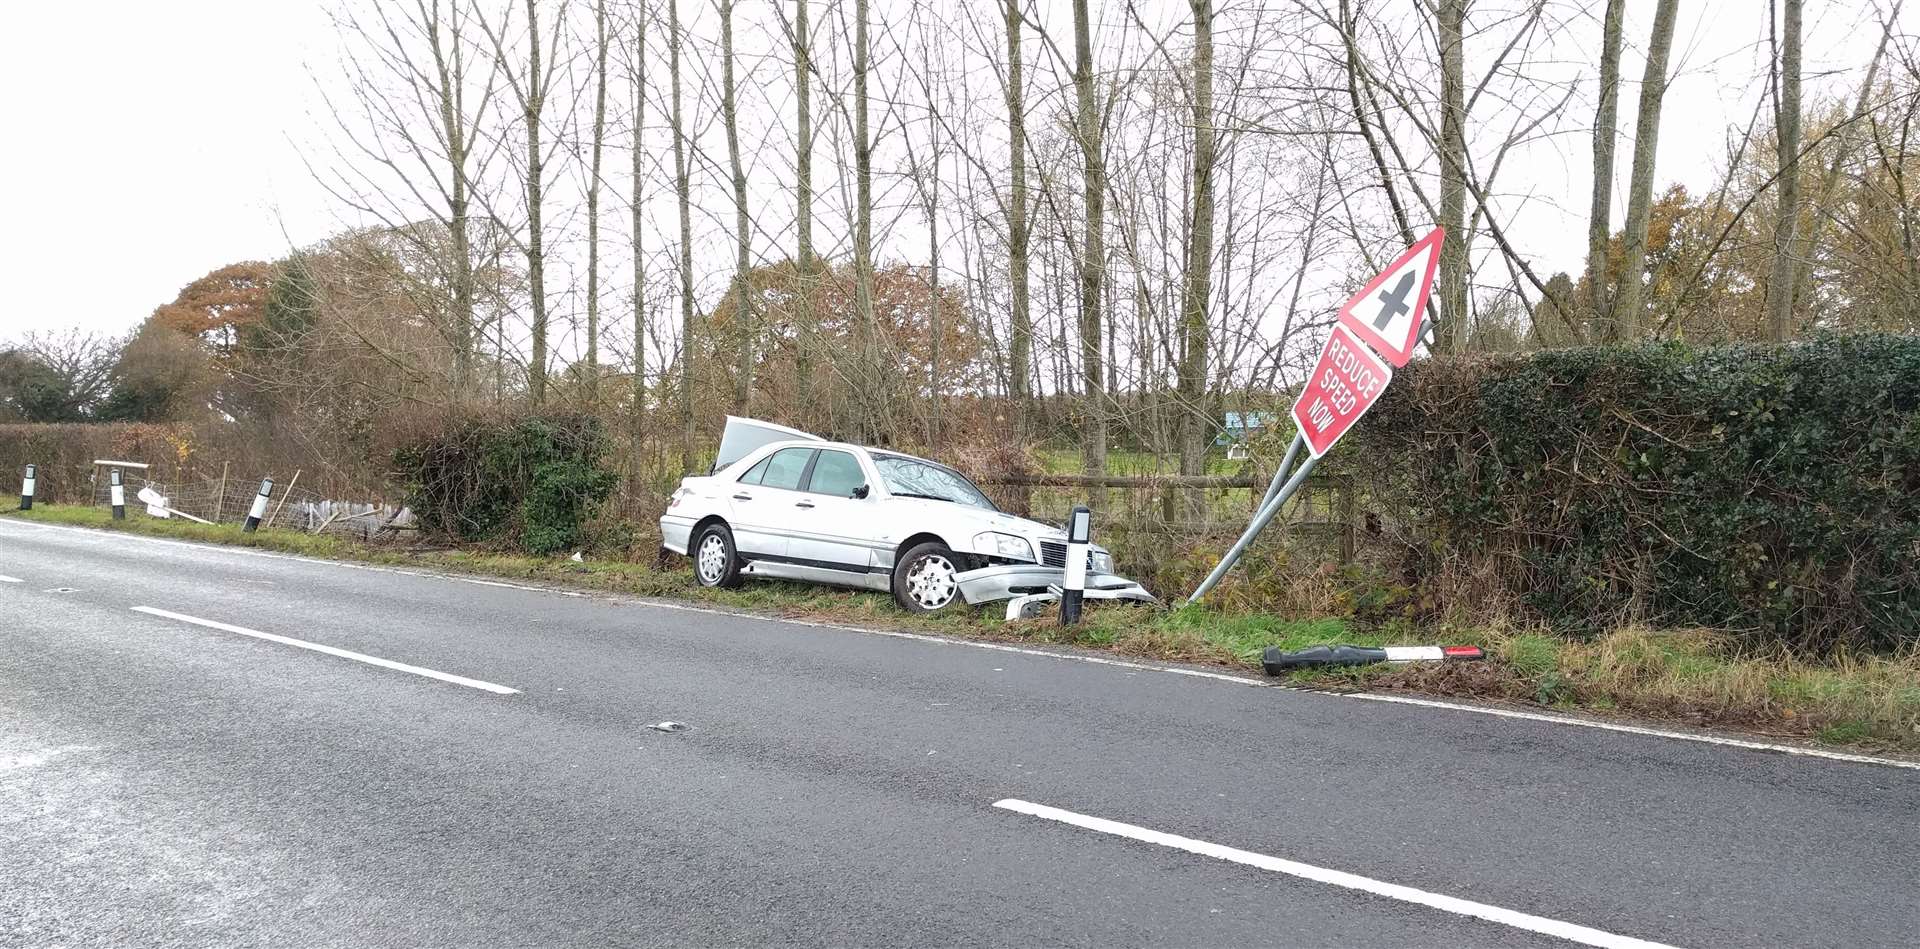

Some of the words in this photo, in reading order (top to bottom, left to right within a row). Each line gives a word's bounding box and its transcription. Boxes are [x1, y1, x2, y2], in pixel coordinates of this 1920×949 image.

[1320, 368, 1357, 416] SPEED
[1328, 338, 1379, 399] REDUCE
[1307, 396, 1335, 433] NOW
